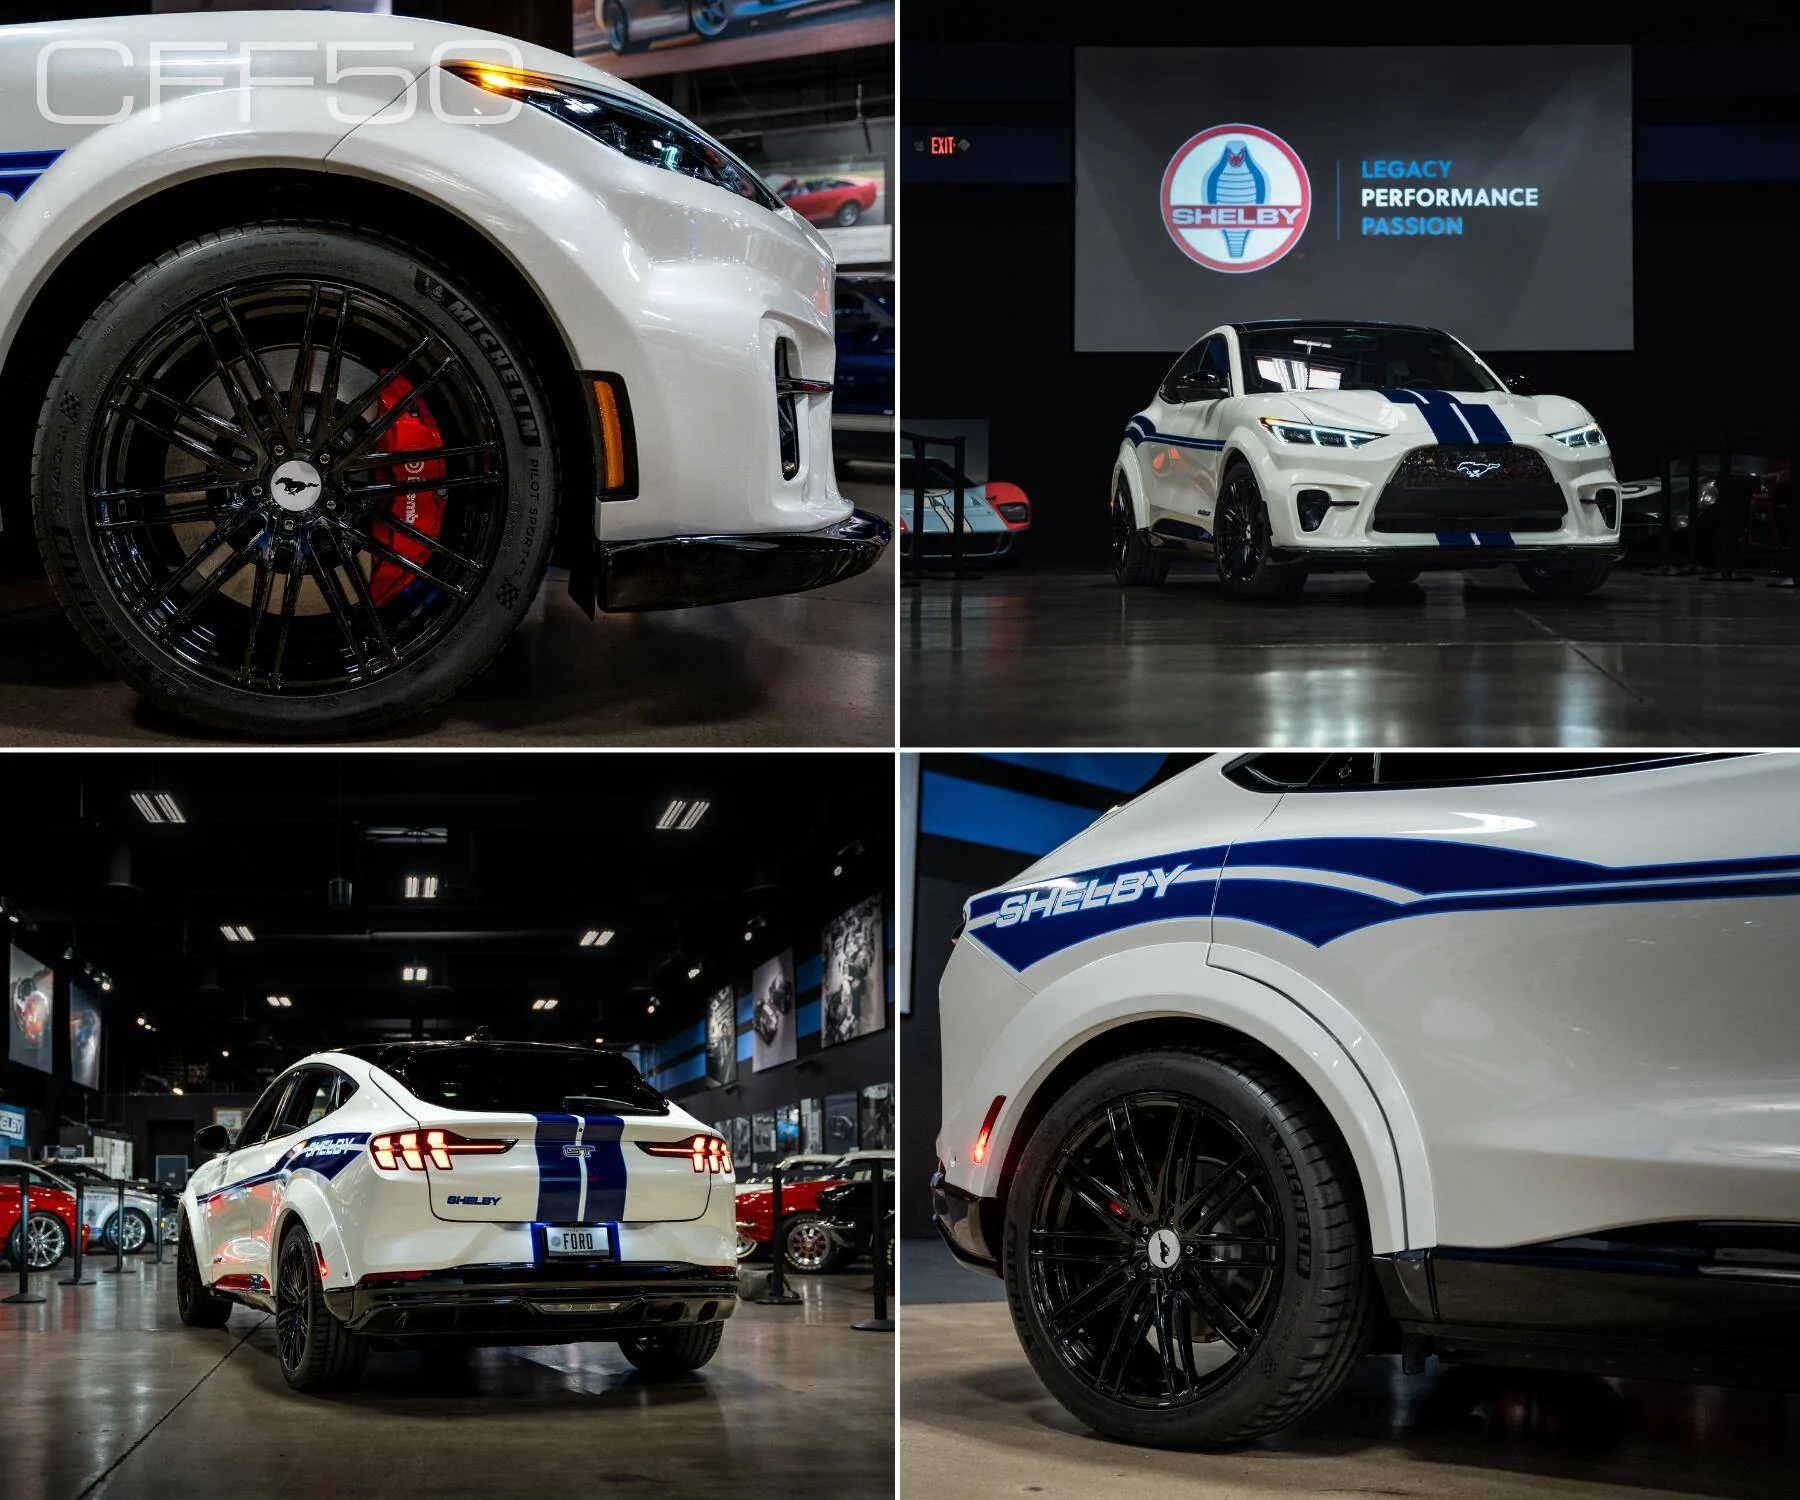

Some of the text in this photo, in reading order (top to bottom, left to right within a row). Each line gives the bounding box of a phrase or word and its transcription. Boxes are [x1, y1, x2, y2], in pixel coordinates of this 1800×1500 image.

[931, 136, 954, 154] EXIT
[1361, 160, 1453, 179] LEGACY
[1361, 187, 1539, 207] PERFORMANCE
[1171, 208, 1303, 225] SHELBY
[1361, 216, 1463, 236] PASSION
[448, 301, 538, 437] MICHELIN
[530, 459, 540, 502] PILOT
[405, 476, 419, 524] bemb
[521, 508, 538, 558] SPORT
[996, 862, 1193, 928] SHELBY
[0, 1116, 22, 1134] ELBY
[305, 1137, 356, 1157] SHELBY
[562, 1145, 596, 1158] GT
[446, 1195, 502, 1206] SHELBY
[1276, 1147, 1311, 1271] MICHELIN
[563, 1233, 593, 1250] FORD
